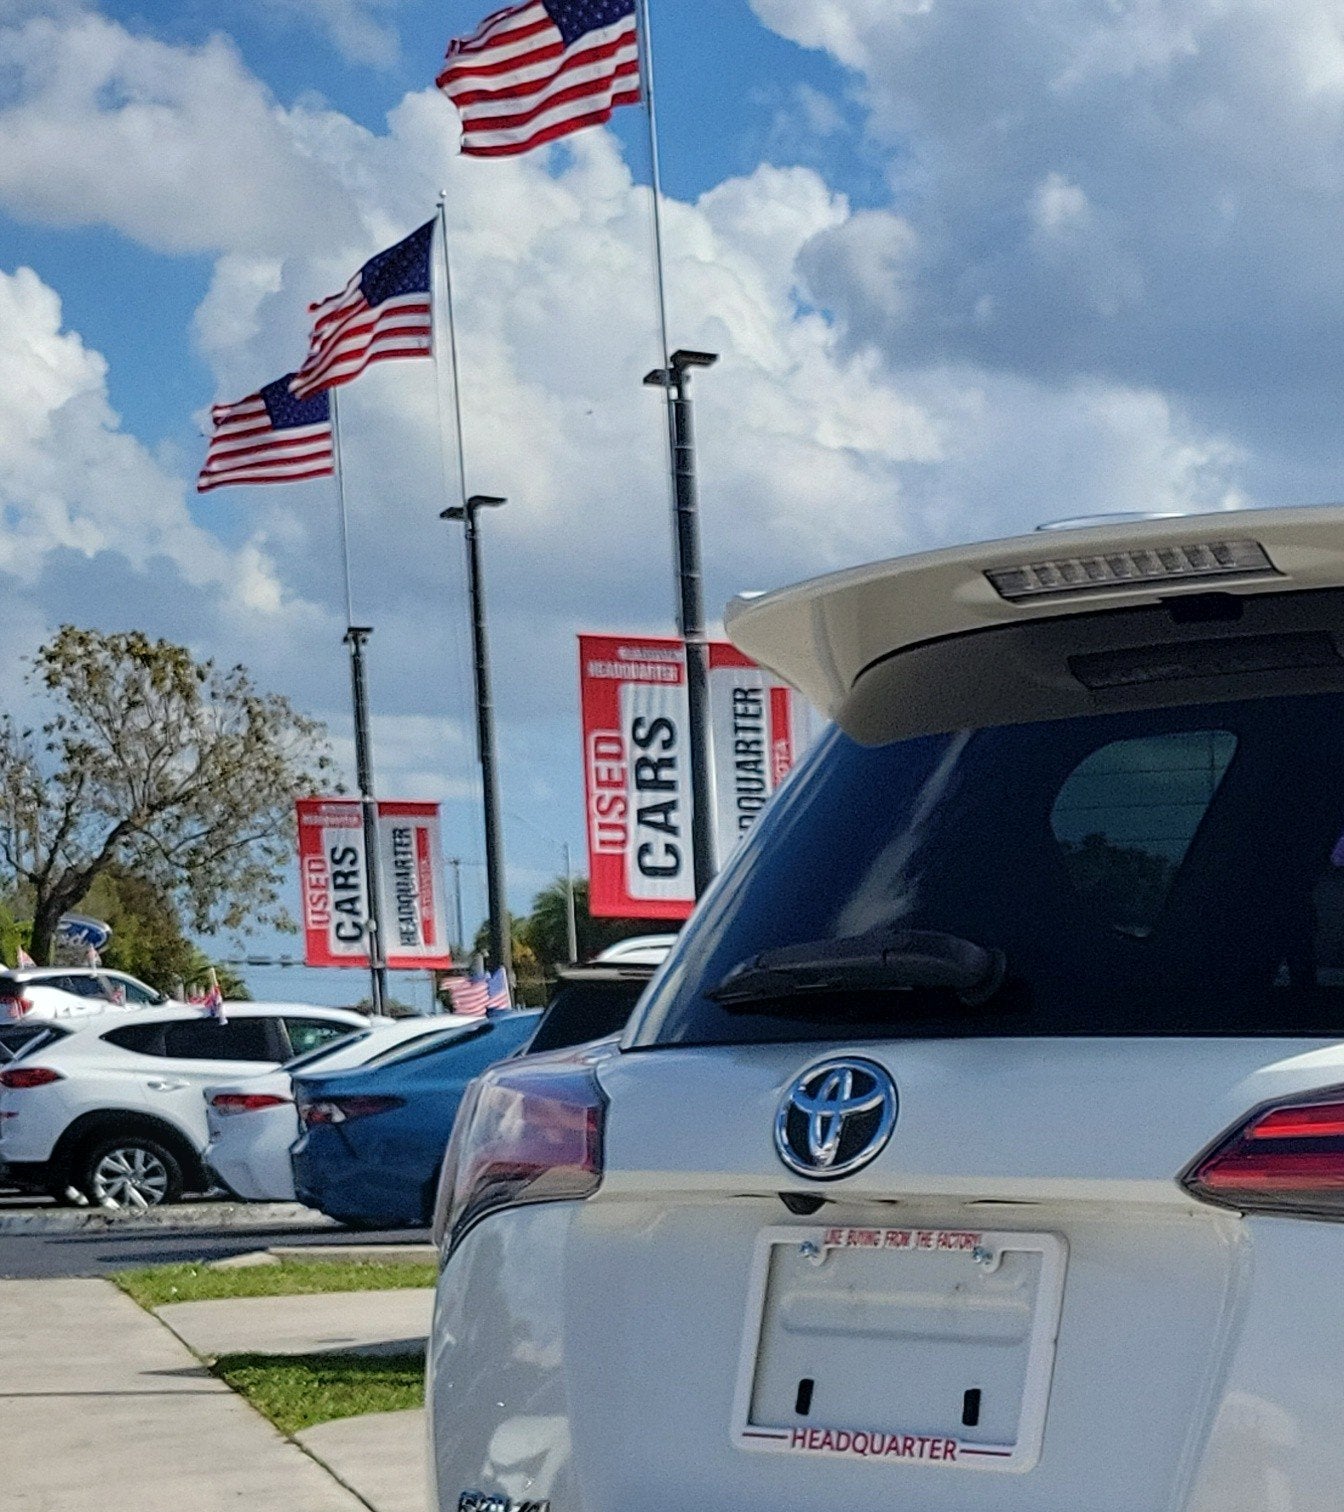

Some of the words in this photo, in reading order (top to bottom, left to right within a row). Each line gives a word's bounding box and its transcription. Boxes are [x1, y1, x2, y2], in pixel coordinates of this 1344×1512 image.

[593, 733, 628, 852] USED
[631, 715, 682, 879] CARS
[307, 857, 330, 925] USED
[330, 846, 363, 942] CARS
[790, 1428, 958, 1462] HEADQUARTER
